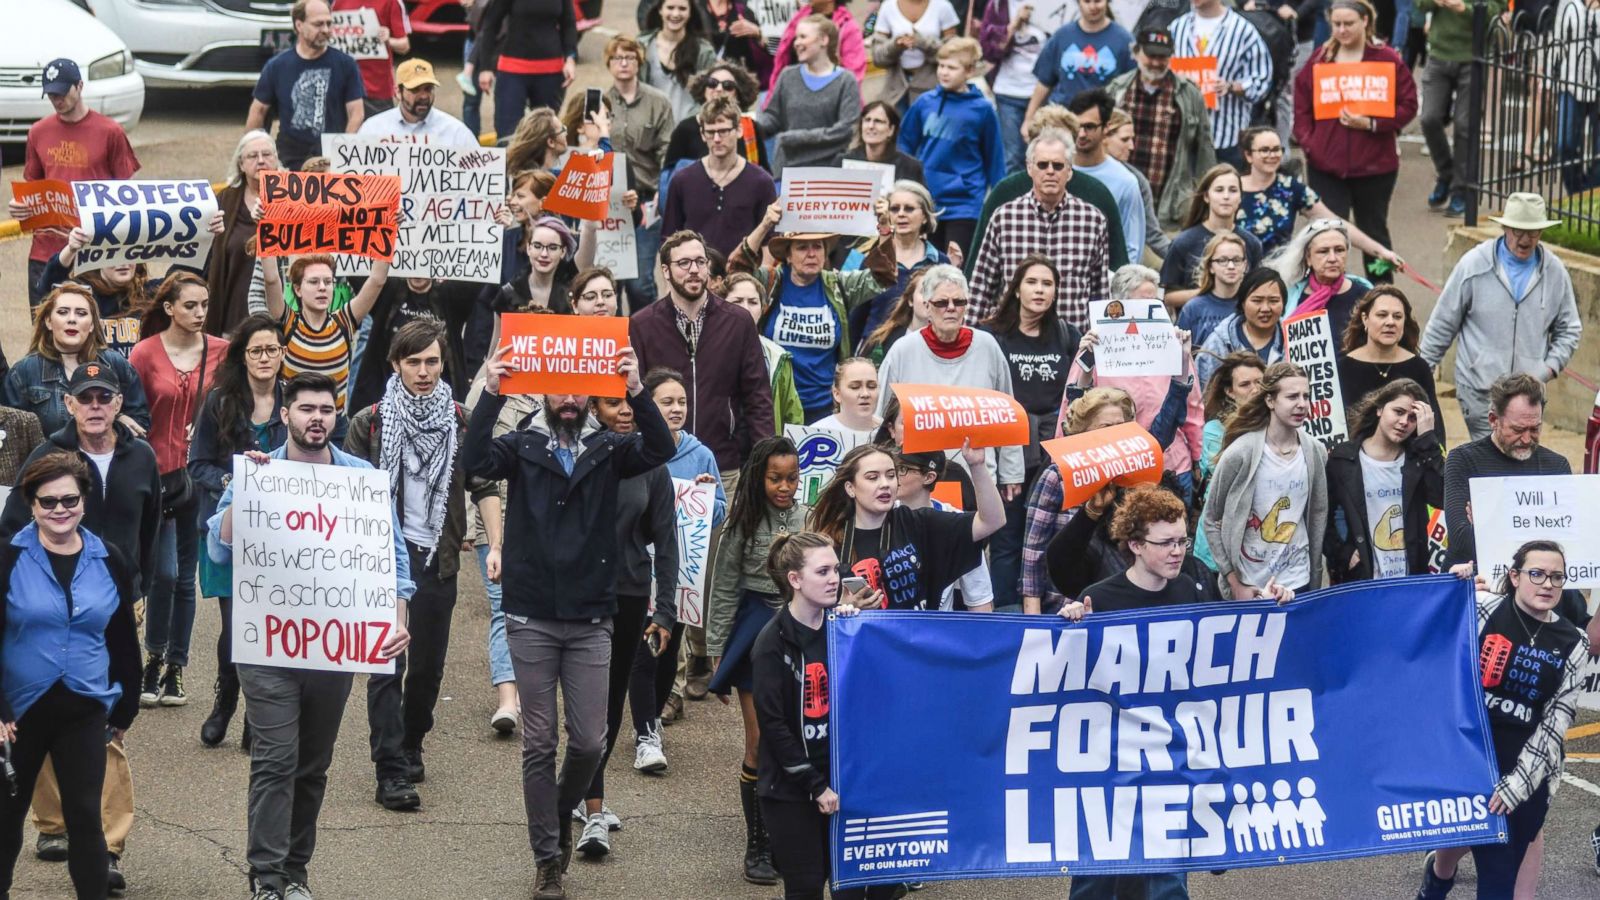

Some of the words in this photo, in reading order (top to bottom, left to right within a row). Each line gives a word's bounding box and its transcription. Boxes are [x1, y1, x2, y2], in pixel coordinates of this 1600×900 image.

[1339, 75, 1363, 90] CAN
[1364, 75, 1388, 90] END
[1342, 88, 1388, 102] VIOLENCE
[337, 144, 399, 168] SANDY
[409, 146, 457, 168] HOOK
[264, 173, 363, 206] BOOKS
[343, 168, 504, 196] UMBINE
[566, 170, 585, 187] WE
[22, 192, 42, 206] WE
[45, 190, 70, 205] CAN
[74, 182, 210, 207] PROTECT
[558, 184, 582, 201] GUN
[29, 204, 49, 217] UN
[339, 206, 388, 226] NOT
[421, 197, 502, 222] AGAIN
[787, 201, 870, 212] EVERYTOWN
[90, 206, 203, 247] KIDS
[421, 224, 499, 245] MILLS
[259, 221, 395, 263] BULLETS
[77, 246, 121, 267] NOT
[124, 241, 200, 261] GUNS
[419, 247, 501, 269] STONEMAN
[430, 264, 489, 279] DOUGLAS
[779, 330, 814, 345] LIVES
[1287, 316, 1322, 342] SMART
[511, 335, 537, 355] WE
[542, 336, 577, 356] CAN
[582, 338, 616, 358] END
[1289, 339, 1328, 363] POLICY
[511, 355, 542, 373] GUN
[545, 357, 616, 375] VIOLENCE
[908, 396, 937, 412] WE
[939, 395, 975, 410] CAN
[976, 394, 1011, 409] END
[913, 413, 946, 431] GUN
[947, 408, 1018, 428] VIOLENCE
[1061, 452, 1089, 470] WE
[1089, 444, 1119, 464] CAN
[1118, 435, 1150, 455] END
[1072, 469, 1101, 488] GUN
[1101, 450, 1157, 480] VIOLENCE
[244, 458, 347, 499] Remember
[348, 476, 390, 505] When
[1515, 490, 1544, 506] Will
[1553, 491, 1558, 506] I
[242, 500, 281, 531] the
[285, 503, 338, 541] only
[339, 507, 391, 549] thing
[1513, 516, 1531, 529] Be
[1534, 515, 1572, 529] Next?
[282, 547, 336, 571] were
[340, 544, 391, 575] afraid
[885, 561, 913, 578] FOR
[287, 577, 357, 608] school
[364, 586, 396, 609] was
[889, 573, 917, 591] OUR
[244, 621, 259, 644] a
[265, 614, 321, 660] POP
[322, 618, 393, 665] QUIZ
[1010, 612, 1288, 696] MARCH
[1513, 656, 1541, 674] FOR
[1516, 645, 1563, 670] MARCH
[1508, 669, 1540, 685] OUR
[1004, 703, 1173, 775] FOR
[1173, 687, 1320, 770] OUR
[1004, 783, 1227, 864] LIVES
[1376, 794, 1488, 831] GIFFORDS
[1381, 830, 1412, 841] COURAGE
[1412, 830, 1422, 838] TO
[1422, 828, 1441, 837] FIGHT
[1442, 826, 1456, 835] GUN
[1456, 823, 1489, 833] VIOLENCE
[843, 839, 949, 861] EVERYTOWN
[859, 862, 876, 872] FOR
[876, 860, 896, 870] GUN
[896, 858, 931, 868] SAFETY
